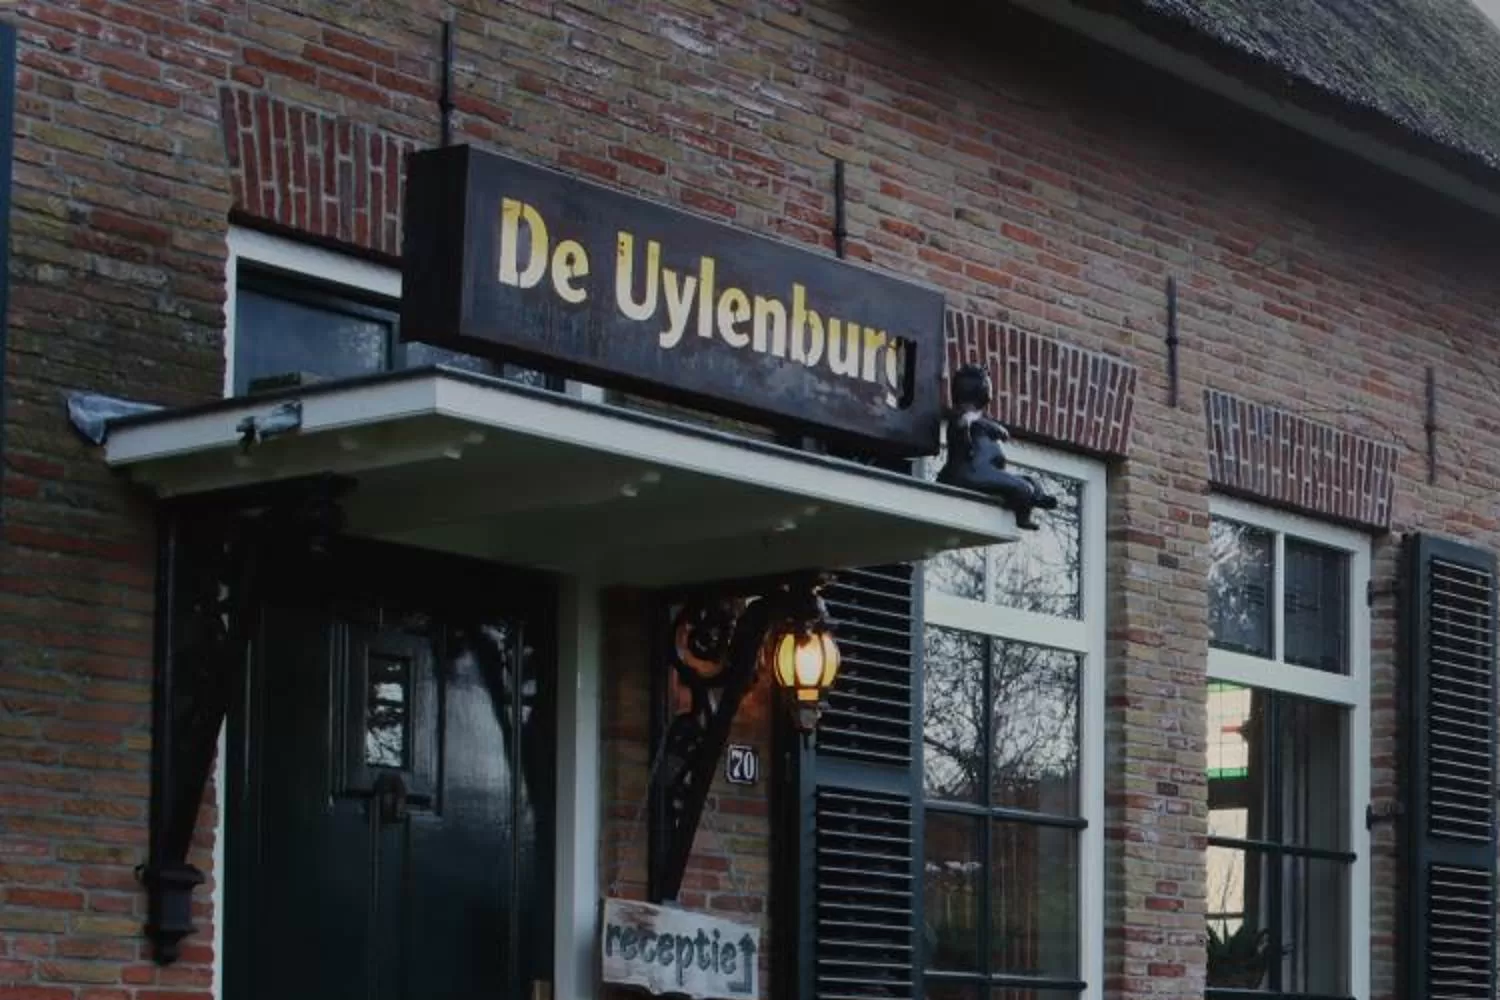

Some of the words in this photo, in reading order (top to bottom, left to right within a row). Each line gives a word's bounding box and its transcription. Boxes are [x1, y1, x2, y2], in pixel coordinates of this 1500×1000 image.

[498, 197, 591, 304] De
[731, 751, 755, 779] 70
[605, 923, 738, 987] receptie
